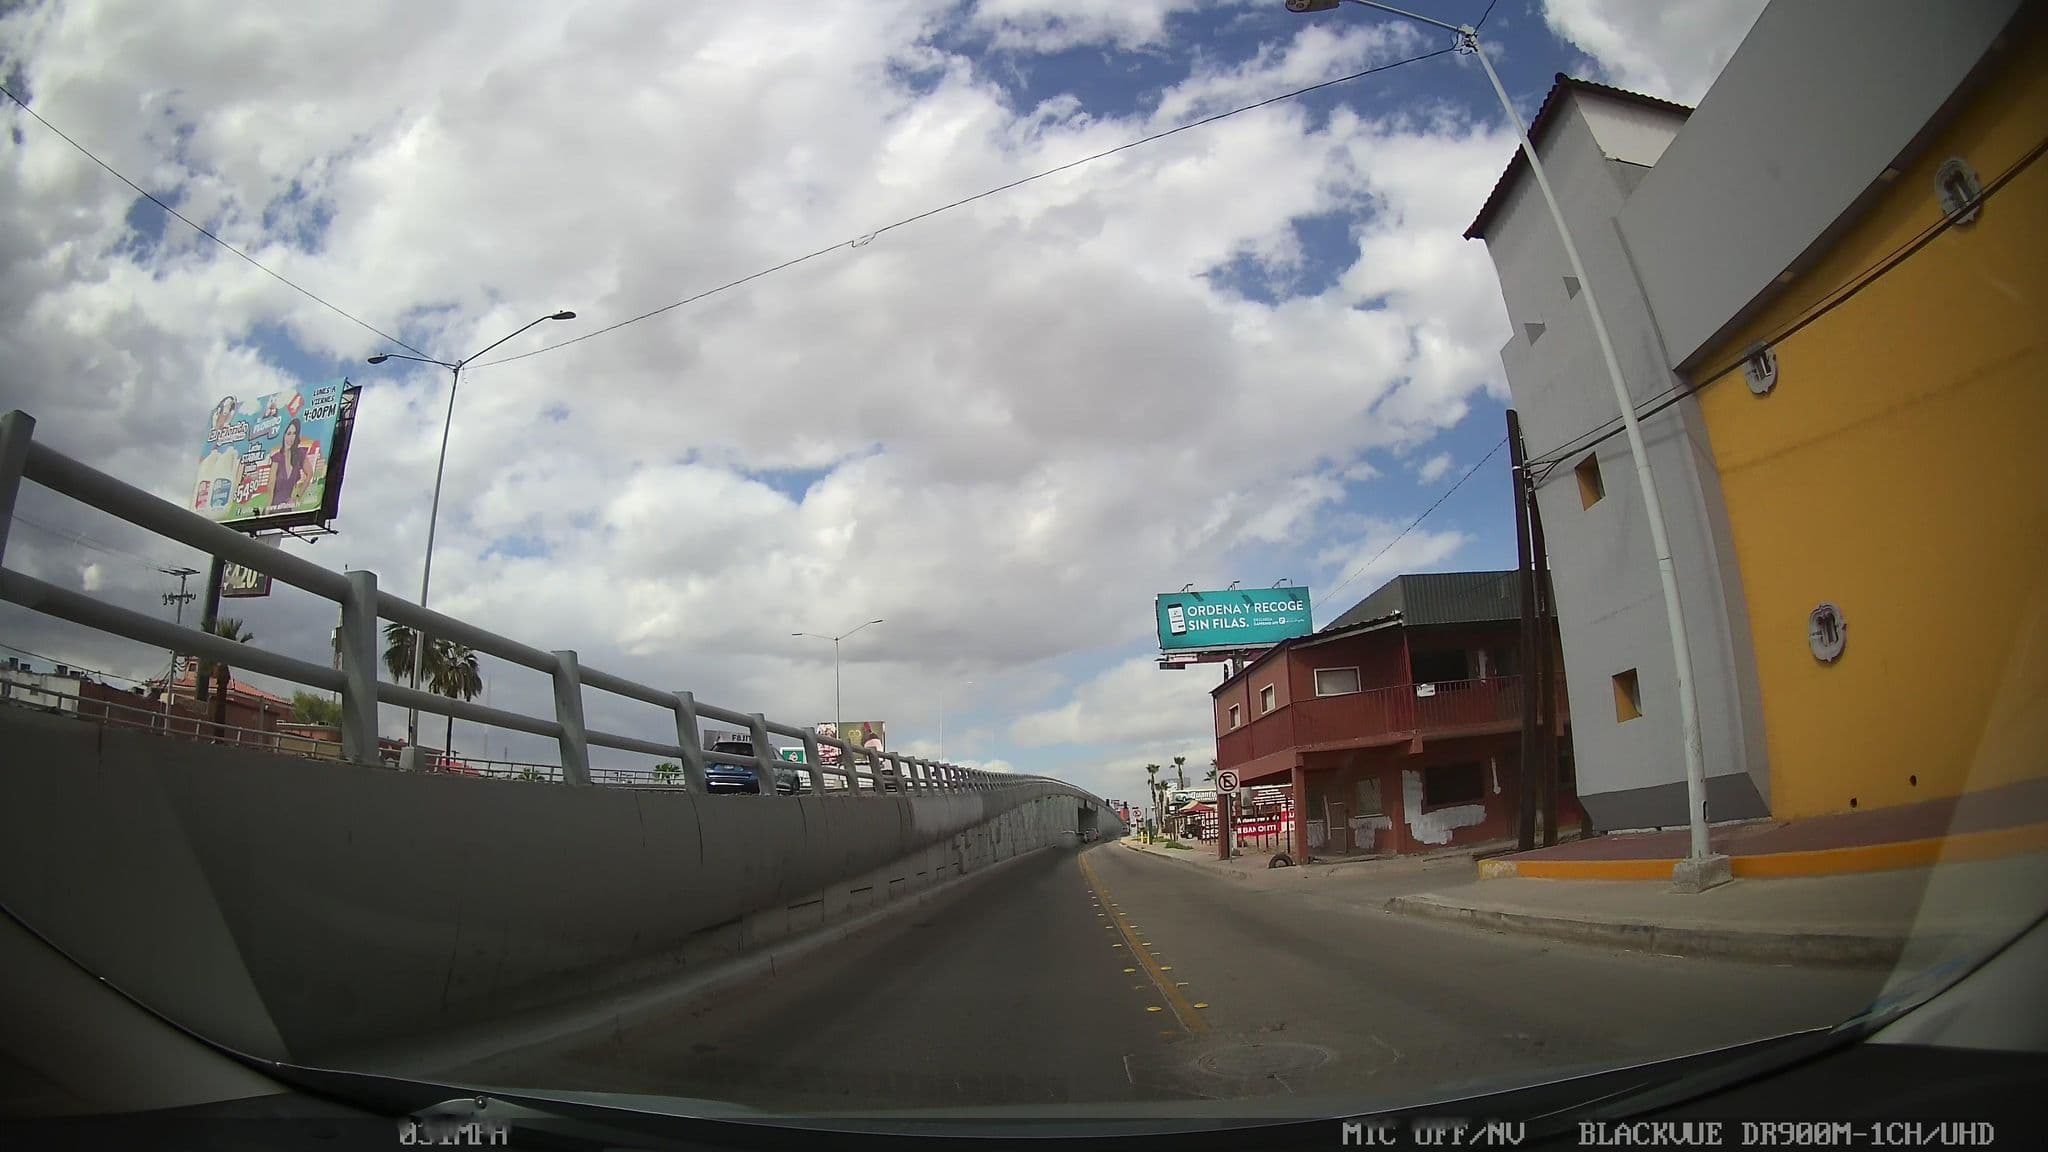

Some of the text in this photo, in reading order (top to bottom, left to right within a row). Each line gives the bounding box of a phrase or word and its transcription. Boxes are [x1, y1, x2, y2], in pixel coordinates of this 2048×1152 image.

[304, 403, 337, 422] 4:00PM
[1187, 600, 1304, 617] ORDENA Y RECOGE
[1188, 617, 1250, 631] SIN FILAS.
